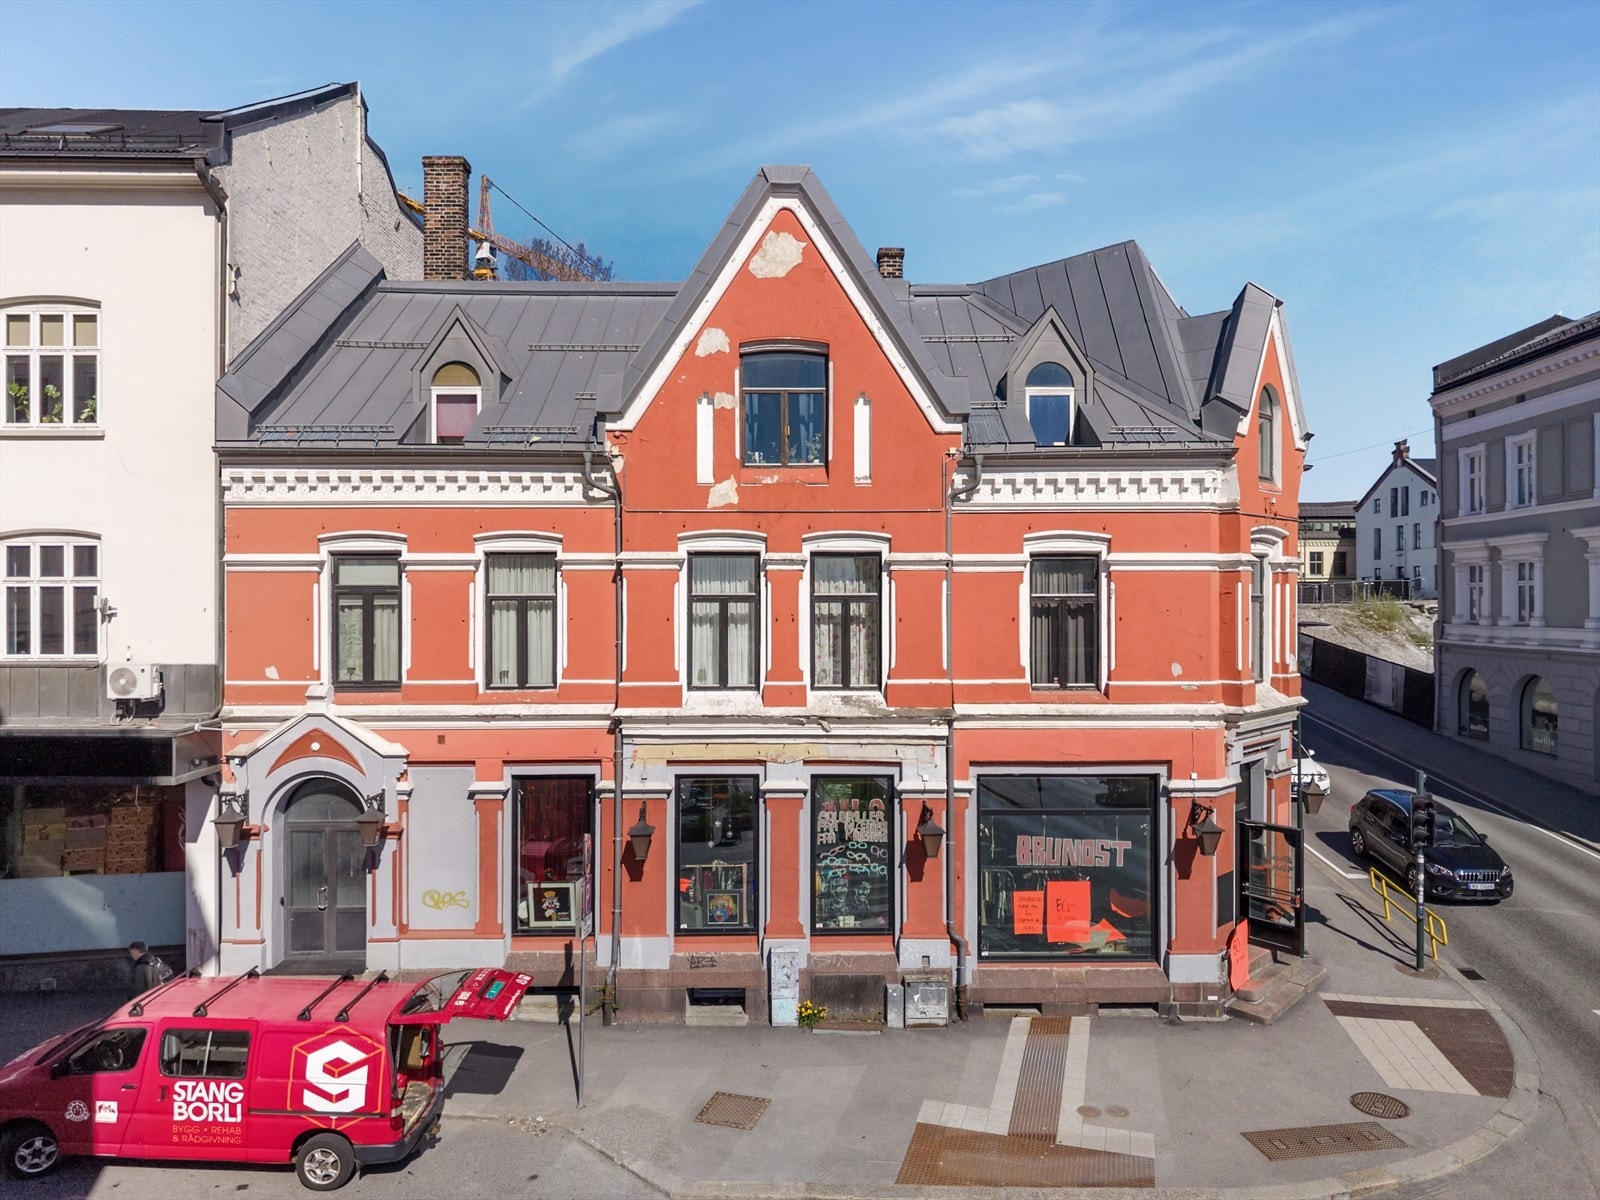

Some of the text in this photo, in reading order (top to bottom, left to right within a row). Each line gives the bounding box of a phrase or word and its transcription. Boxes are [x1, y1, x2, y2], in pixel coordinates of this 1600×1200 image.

[1016, 835, 1132, 867] BRUNOST
[172, 1081, 244, 1103] STANG
[173, 1101, 242, 1123] BORLI
[172, 1125, 241, 1135] BYGG REHAB
[172, 1133, 241, 1145] & RÅDGIVNING
